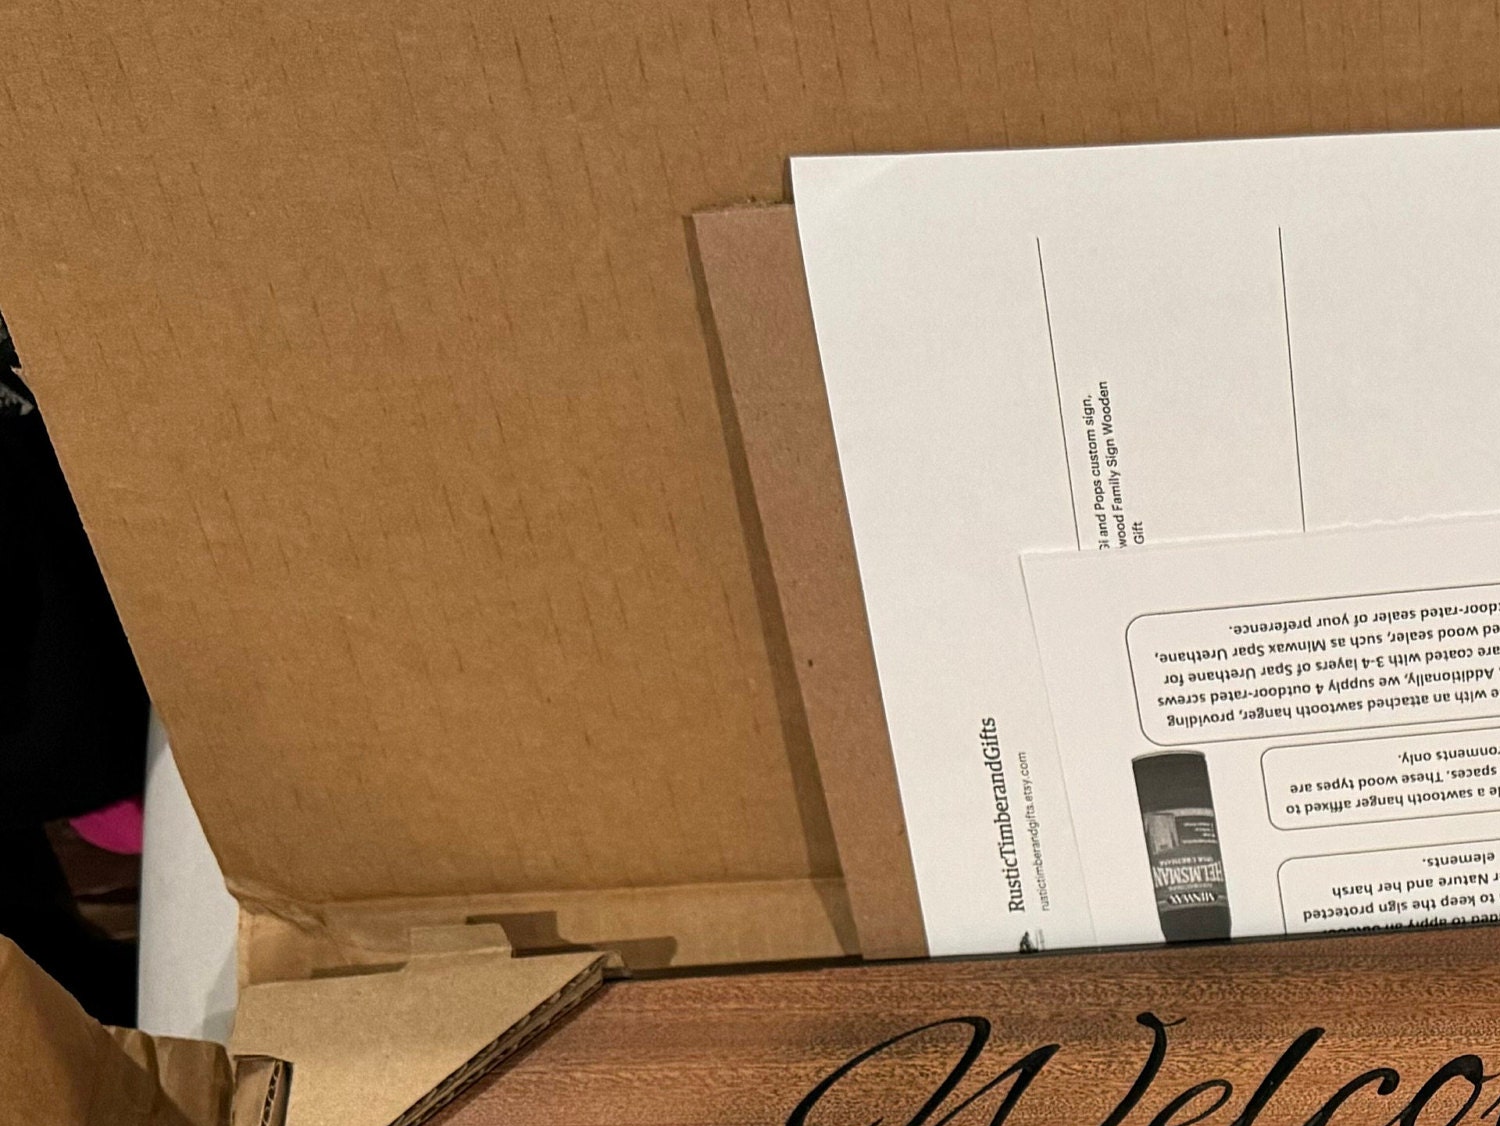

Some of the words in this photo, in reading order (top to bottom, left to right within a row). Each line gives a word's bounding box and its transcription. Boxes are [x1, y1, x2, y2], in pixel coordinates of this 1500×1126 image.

[1082, 394, 1096, 426] sign,
[1099, 381, 1114, 436] Wooden
[1087, 429, 1101, 476] custom
[1106, 438, 1119, 467] Sign
[1094, 479, 1105, 511] Pops
[1108, 470, 1123, 512] Family
[1096, 513, 1109, 538] and
[1113, 514, 1128, 548] wood
[1131, 520, 1145, 545] Gift
[1229, 616, 1312, 635] preference.
[1316, 612, 1350, 628] your
[1353, 613, 1368, 628] of
[1372, 610, 1416, 625] sealer
[1425, 648, 1473, 665] coated
[1478, 645, 1500, 657] are
[1315, 656, 1358, 672] layers
[1361, 655, 1385, 670] 3-4
[1388, 652, 1421, 668] with
[1188, 667, 1256, 683] Urethane
[1260, 662, 1293, 677] Spar
[1297, 662, 1311, 677] of
[1404, 667, 1494, 687] Additionally,
[1164, 673, 1184, 688] for
[1328, 676, 1374, 695] supply
[1379, 675, 1400, 687] we
[1210, 683, 1311, 706] outdoor-rated
[1315, 683, 1324, 696] 4
[1433, 692, 1450, 703] an
[1454, 689, 1487, 704] with
[1157, 693, 1206, 707] screws
[1367, 694, 1429, 713] attached
[1167, 705, 1235, 728] providing
[1239, 706, 1292, 720] hanger,
[1296, 699, 1363, 719] sawtooth
[1398, 751, 1432, 766] only.
[1407, 788, 1473, 806] sawtooth
[1477, 787, 1485, 797] a
[1304, 799, 1352, 816] affixed
[1355, 794, 1404, 808] hanger
[979, 716, 1025, 913] RusticTimberandGifts
[1286, 804, 1301, 815] to
[1018, 751, 1049, 912] rustictimberandgifts.etsy.com
[1422, 851, 1495, 868] elements.
[1152, 860, 1224, 888] HELMSMAN
[1439, 873, 1489, 887] Nature
[1332, 884, 1373, 899] harsh
[1377, 881, 1402, 894] her
[1406, 878, 1433, 893] and
[1412, 898, 1436, 912] the
[1440, 894, 1475, 908] keep
[1480, 892, 1495, 904] to
[1303, 901, 1374, 923] protected
[1379, 899, 1408, 915] sign
